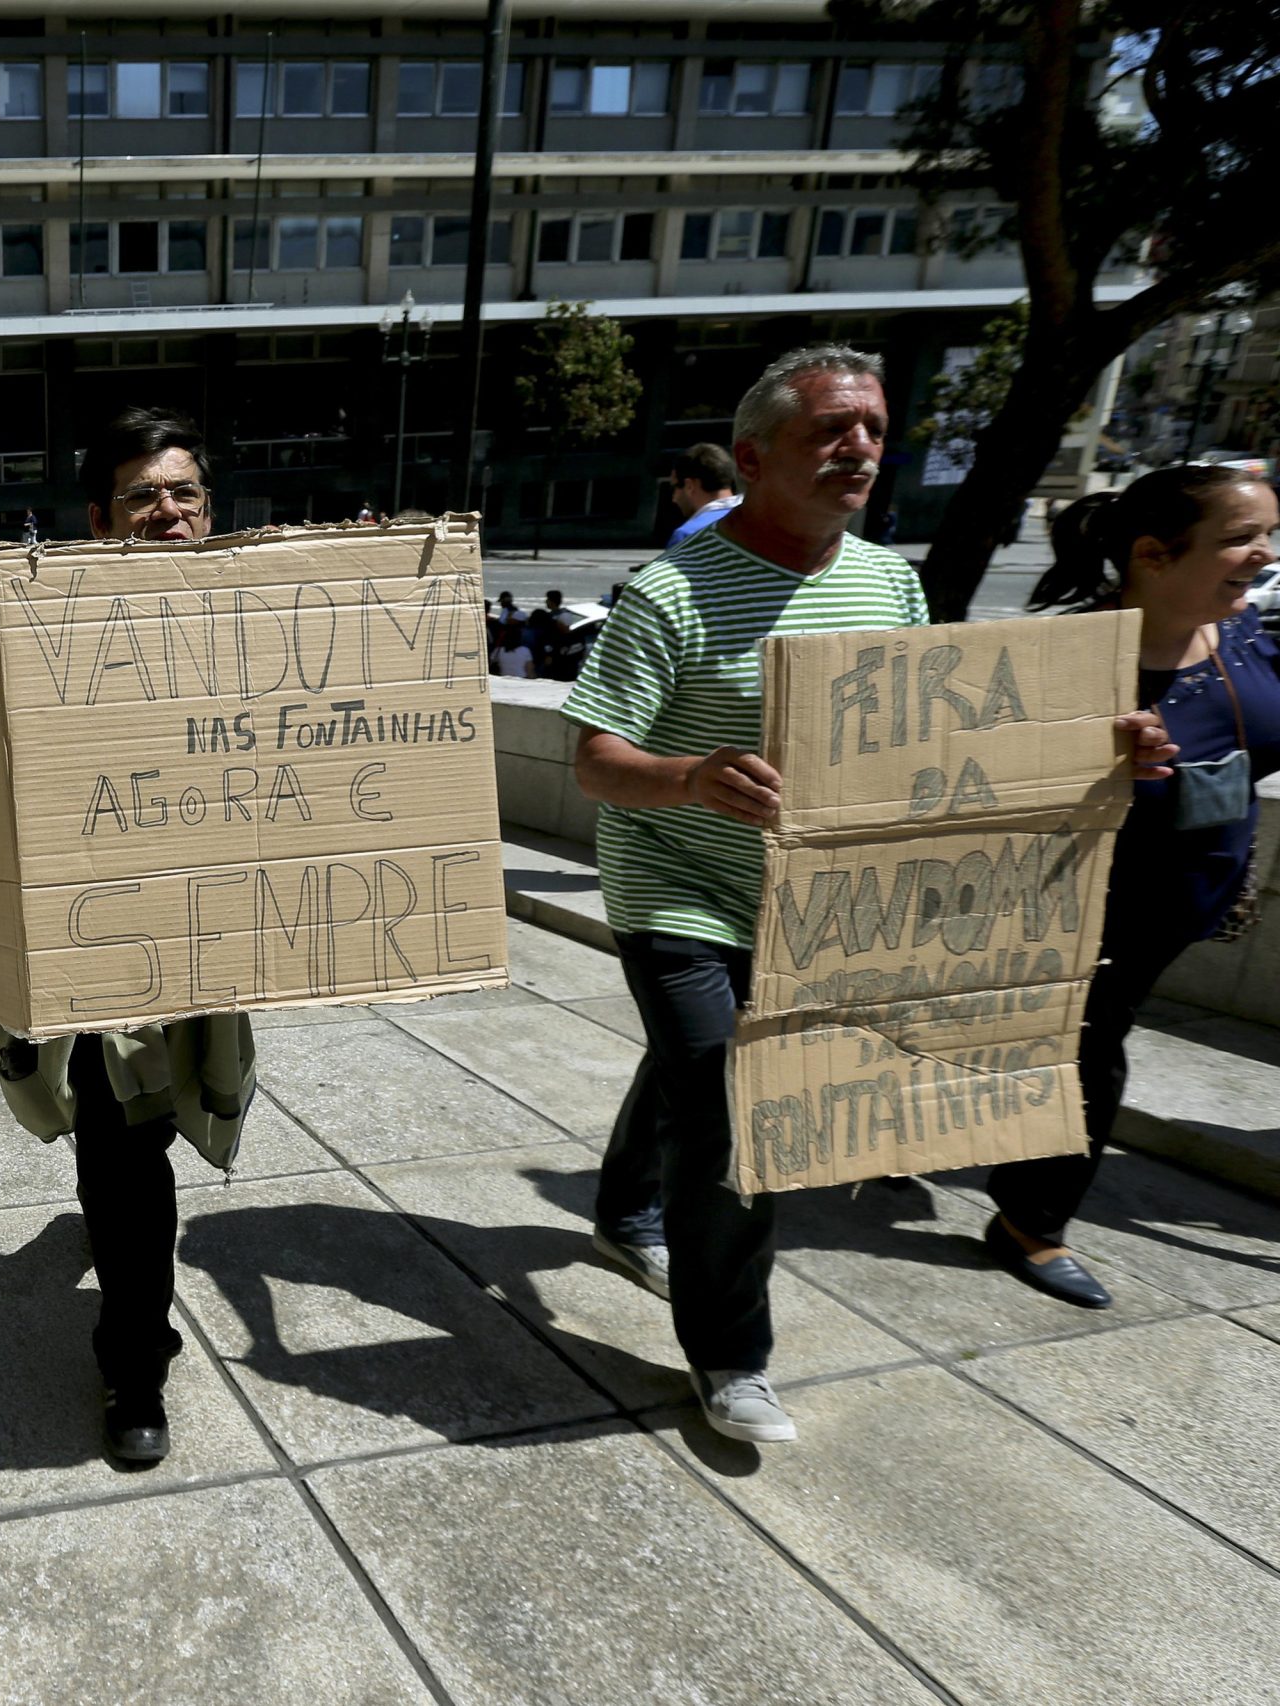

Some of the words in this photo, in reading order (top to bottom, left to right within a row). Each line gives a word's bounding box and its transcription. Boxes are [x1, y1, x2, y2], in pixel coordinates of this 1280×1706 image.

[10, 568, 487, 706] VANDOMA
[186, 711, 257, 755] NAS
[829, 640, 1028, 767] FEIRA
[81, 763, 311, 836] AGORA
[349, 762, 393, 821] E
[908, 756, 999, 821] DA
[67, 850, 491, 1013] SEMPRE
[774, 822, 1079, 970] VANDOMA
